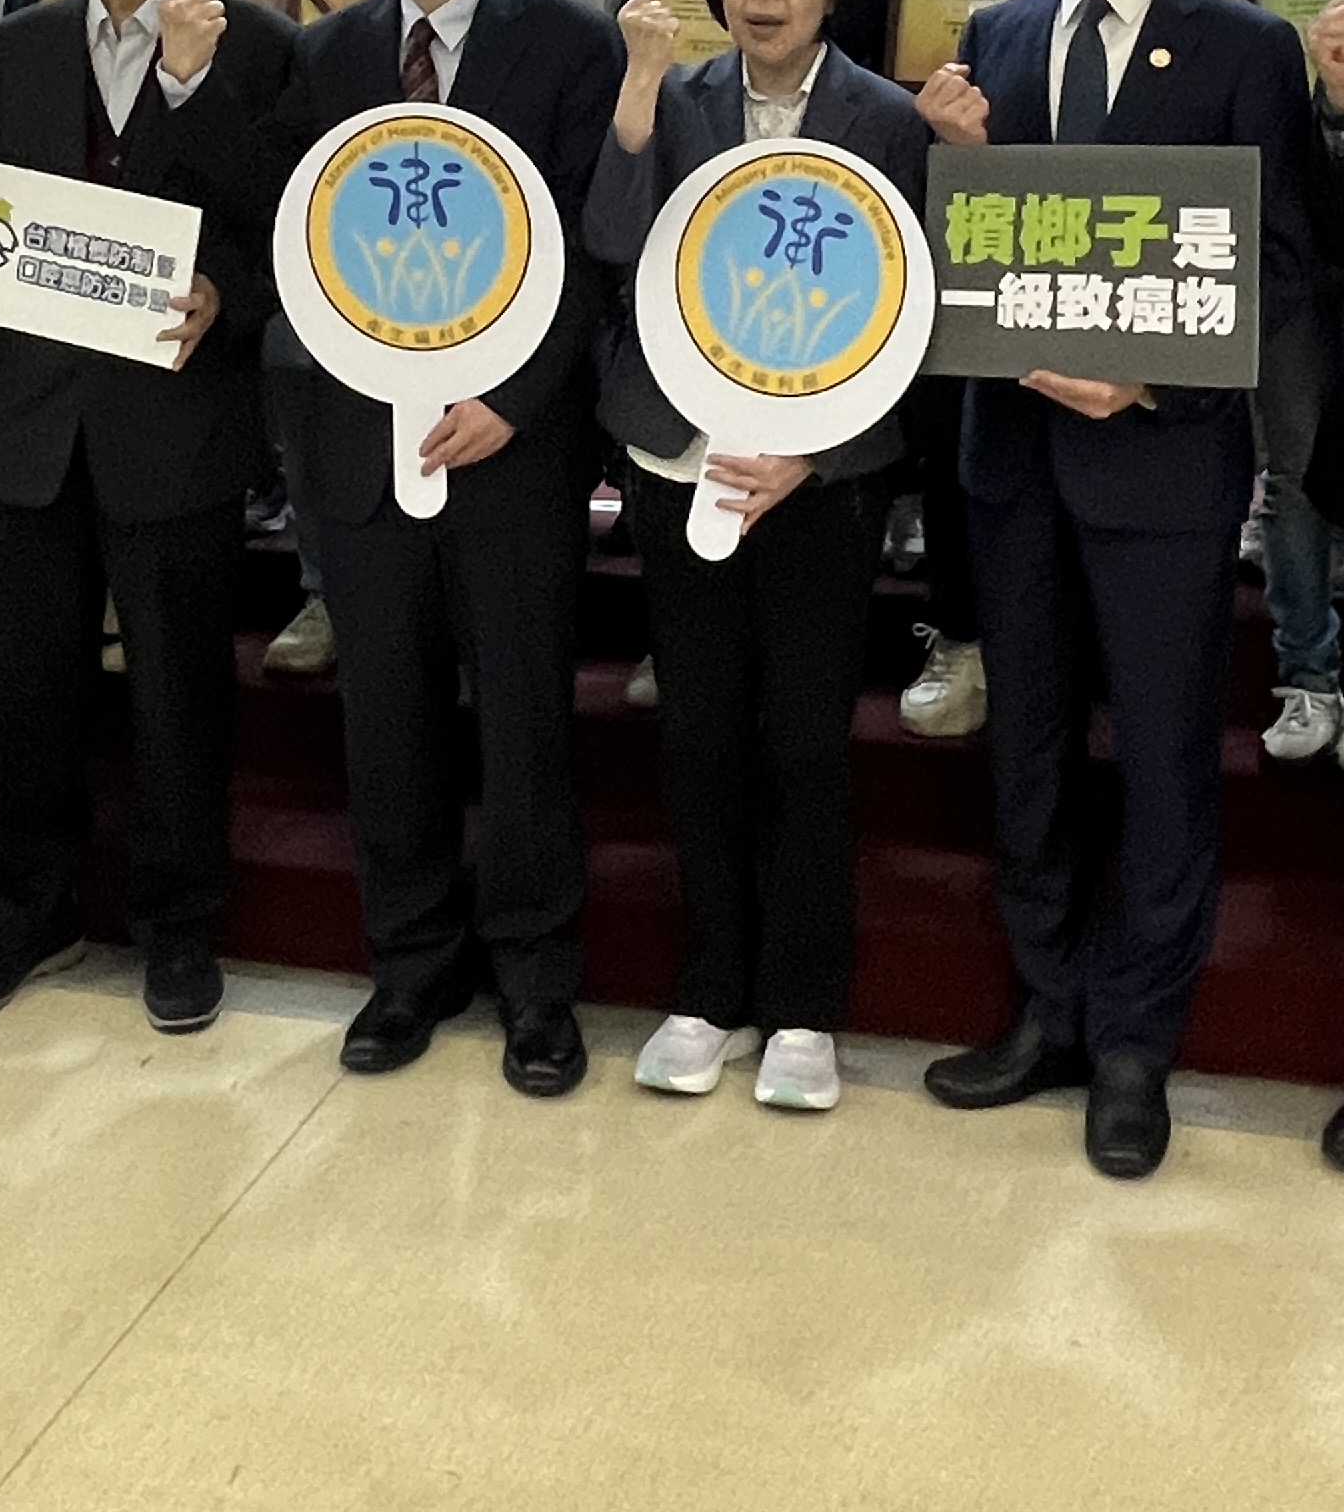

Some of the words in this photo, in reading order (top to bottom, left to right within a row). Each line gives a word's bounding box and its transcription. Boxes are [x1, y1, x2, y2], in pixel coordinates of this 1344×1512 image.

[945, 192, 1237, 270] 檳榔子是
[941, 272, 1237, 336] 一級致癌物
